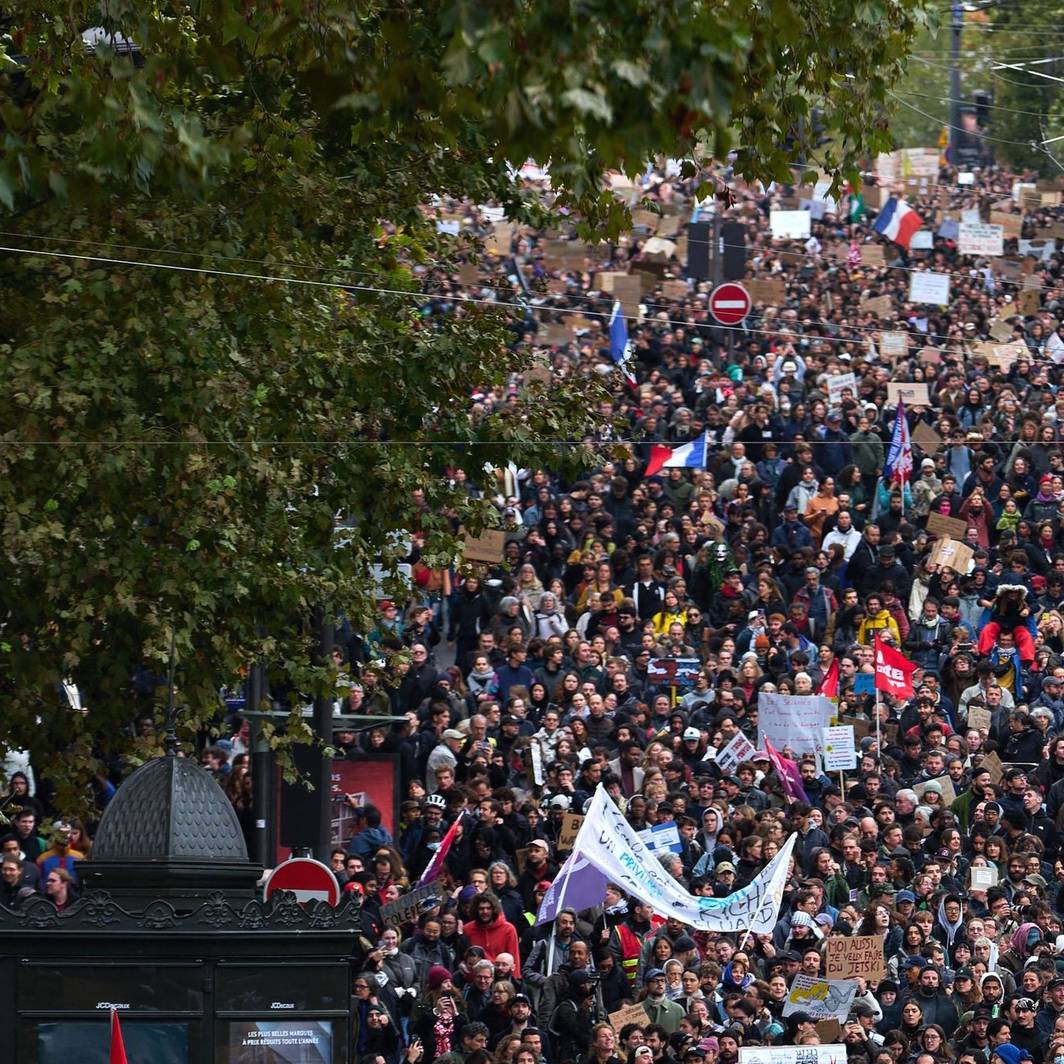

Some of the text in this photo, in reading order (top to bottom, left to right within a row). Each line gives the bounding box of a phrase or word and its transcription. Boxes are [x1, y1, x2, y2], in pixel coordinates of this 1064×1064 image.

[828, 941, 847, 952] MOI
[830, 951, 882, 962] JE VEUX FAIRE
[828, 961, 880, 974] DU JETSKI
